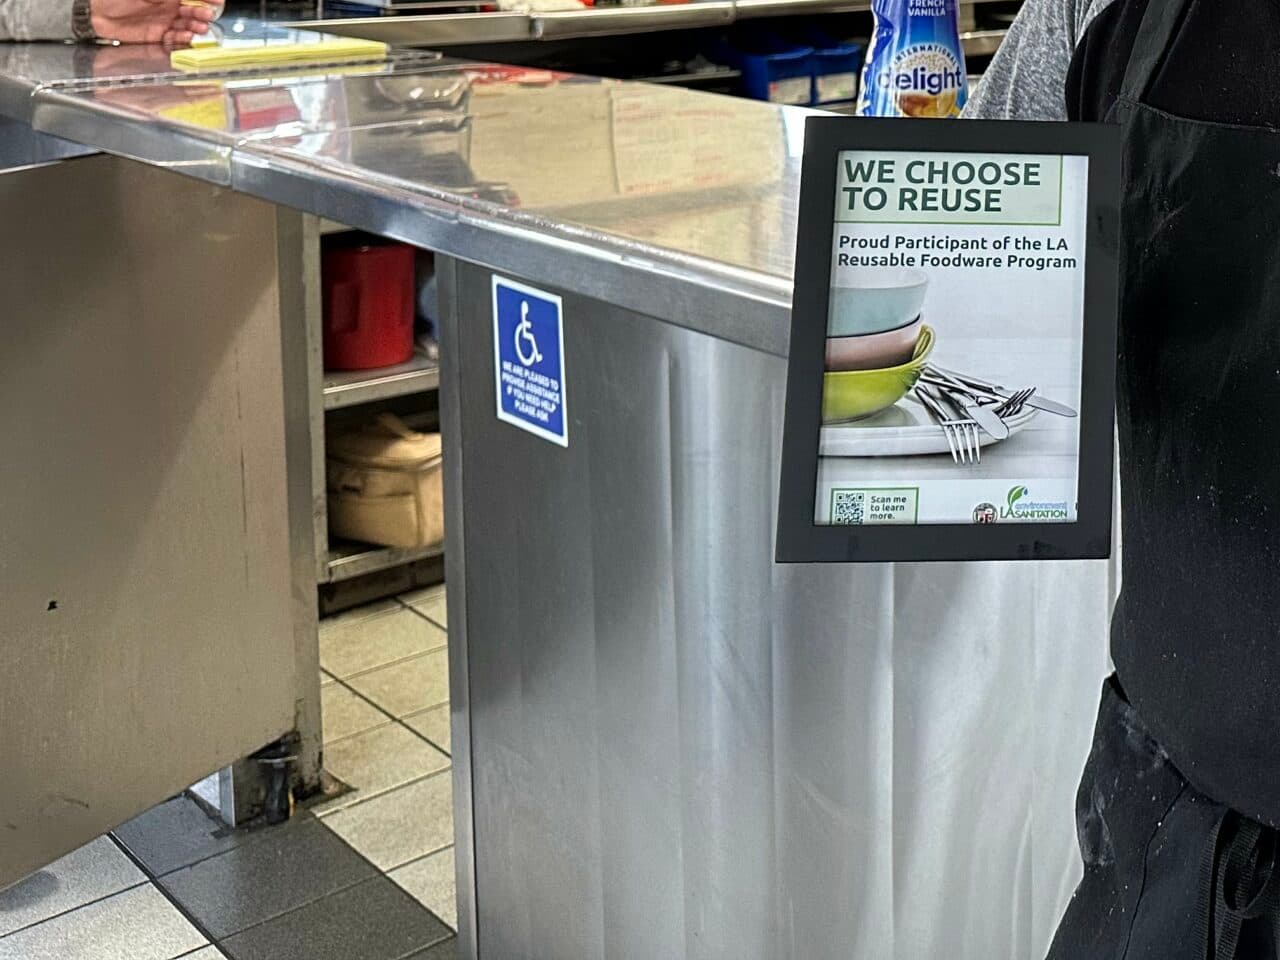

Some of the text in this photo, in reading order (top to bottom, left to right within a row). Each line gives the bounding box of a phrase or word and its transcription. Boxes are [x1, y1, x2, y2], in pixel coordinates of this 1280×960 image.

[907, 7, 946, 17] VANILLA
[877, 67, 963, 96] delight
[844, 159, 1041, 186] WE CHOOSE
[842, 187, 1002, 212] TO REUSE
[839, 235, 1068, 252] Proud Participant of the LA
[838, 253, 1076, 271] Reusable Foodware Program
[870, 495, 907, 504] Scan me
[870, 503, 905, 512] to learn
[1015, 509, 1068, 518] SANITATION
[870, 512, 895, 520] more.
